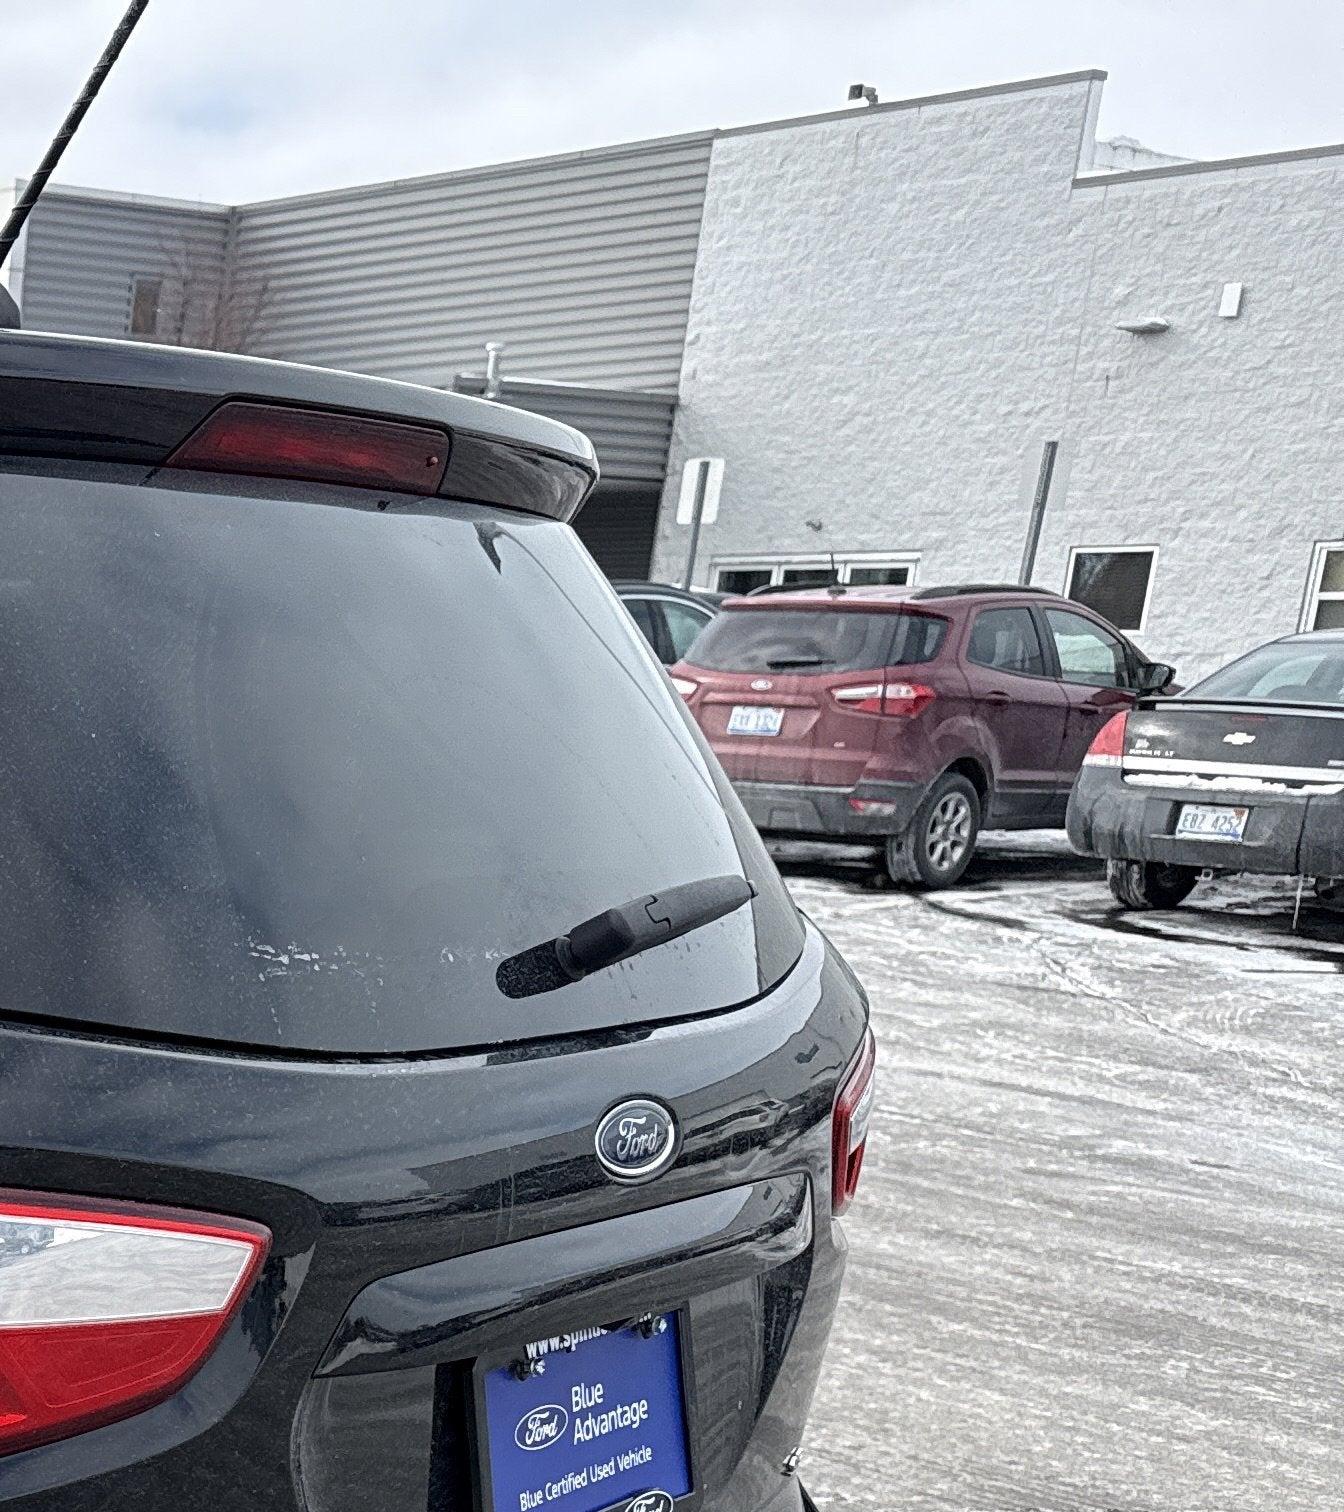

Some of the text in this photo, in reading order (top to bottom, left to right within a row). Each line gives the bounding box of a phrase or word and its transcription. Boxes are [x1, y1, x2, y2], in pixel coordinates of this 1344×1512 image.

[616, 1116, 666, 1160] Ford
[571, 1383, 604, 1413] Blue
[525, 1399, 649, 1445] Ford Advantage
[520, 1445, 653, 1512] Blue Certified Used Vehicle
